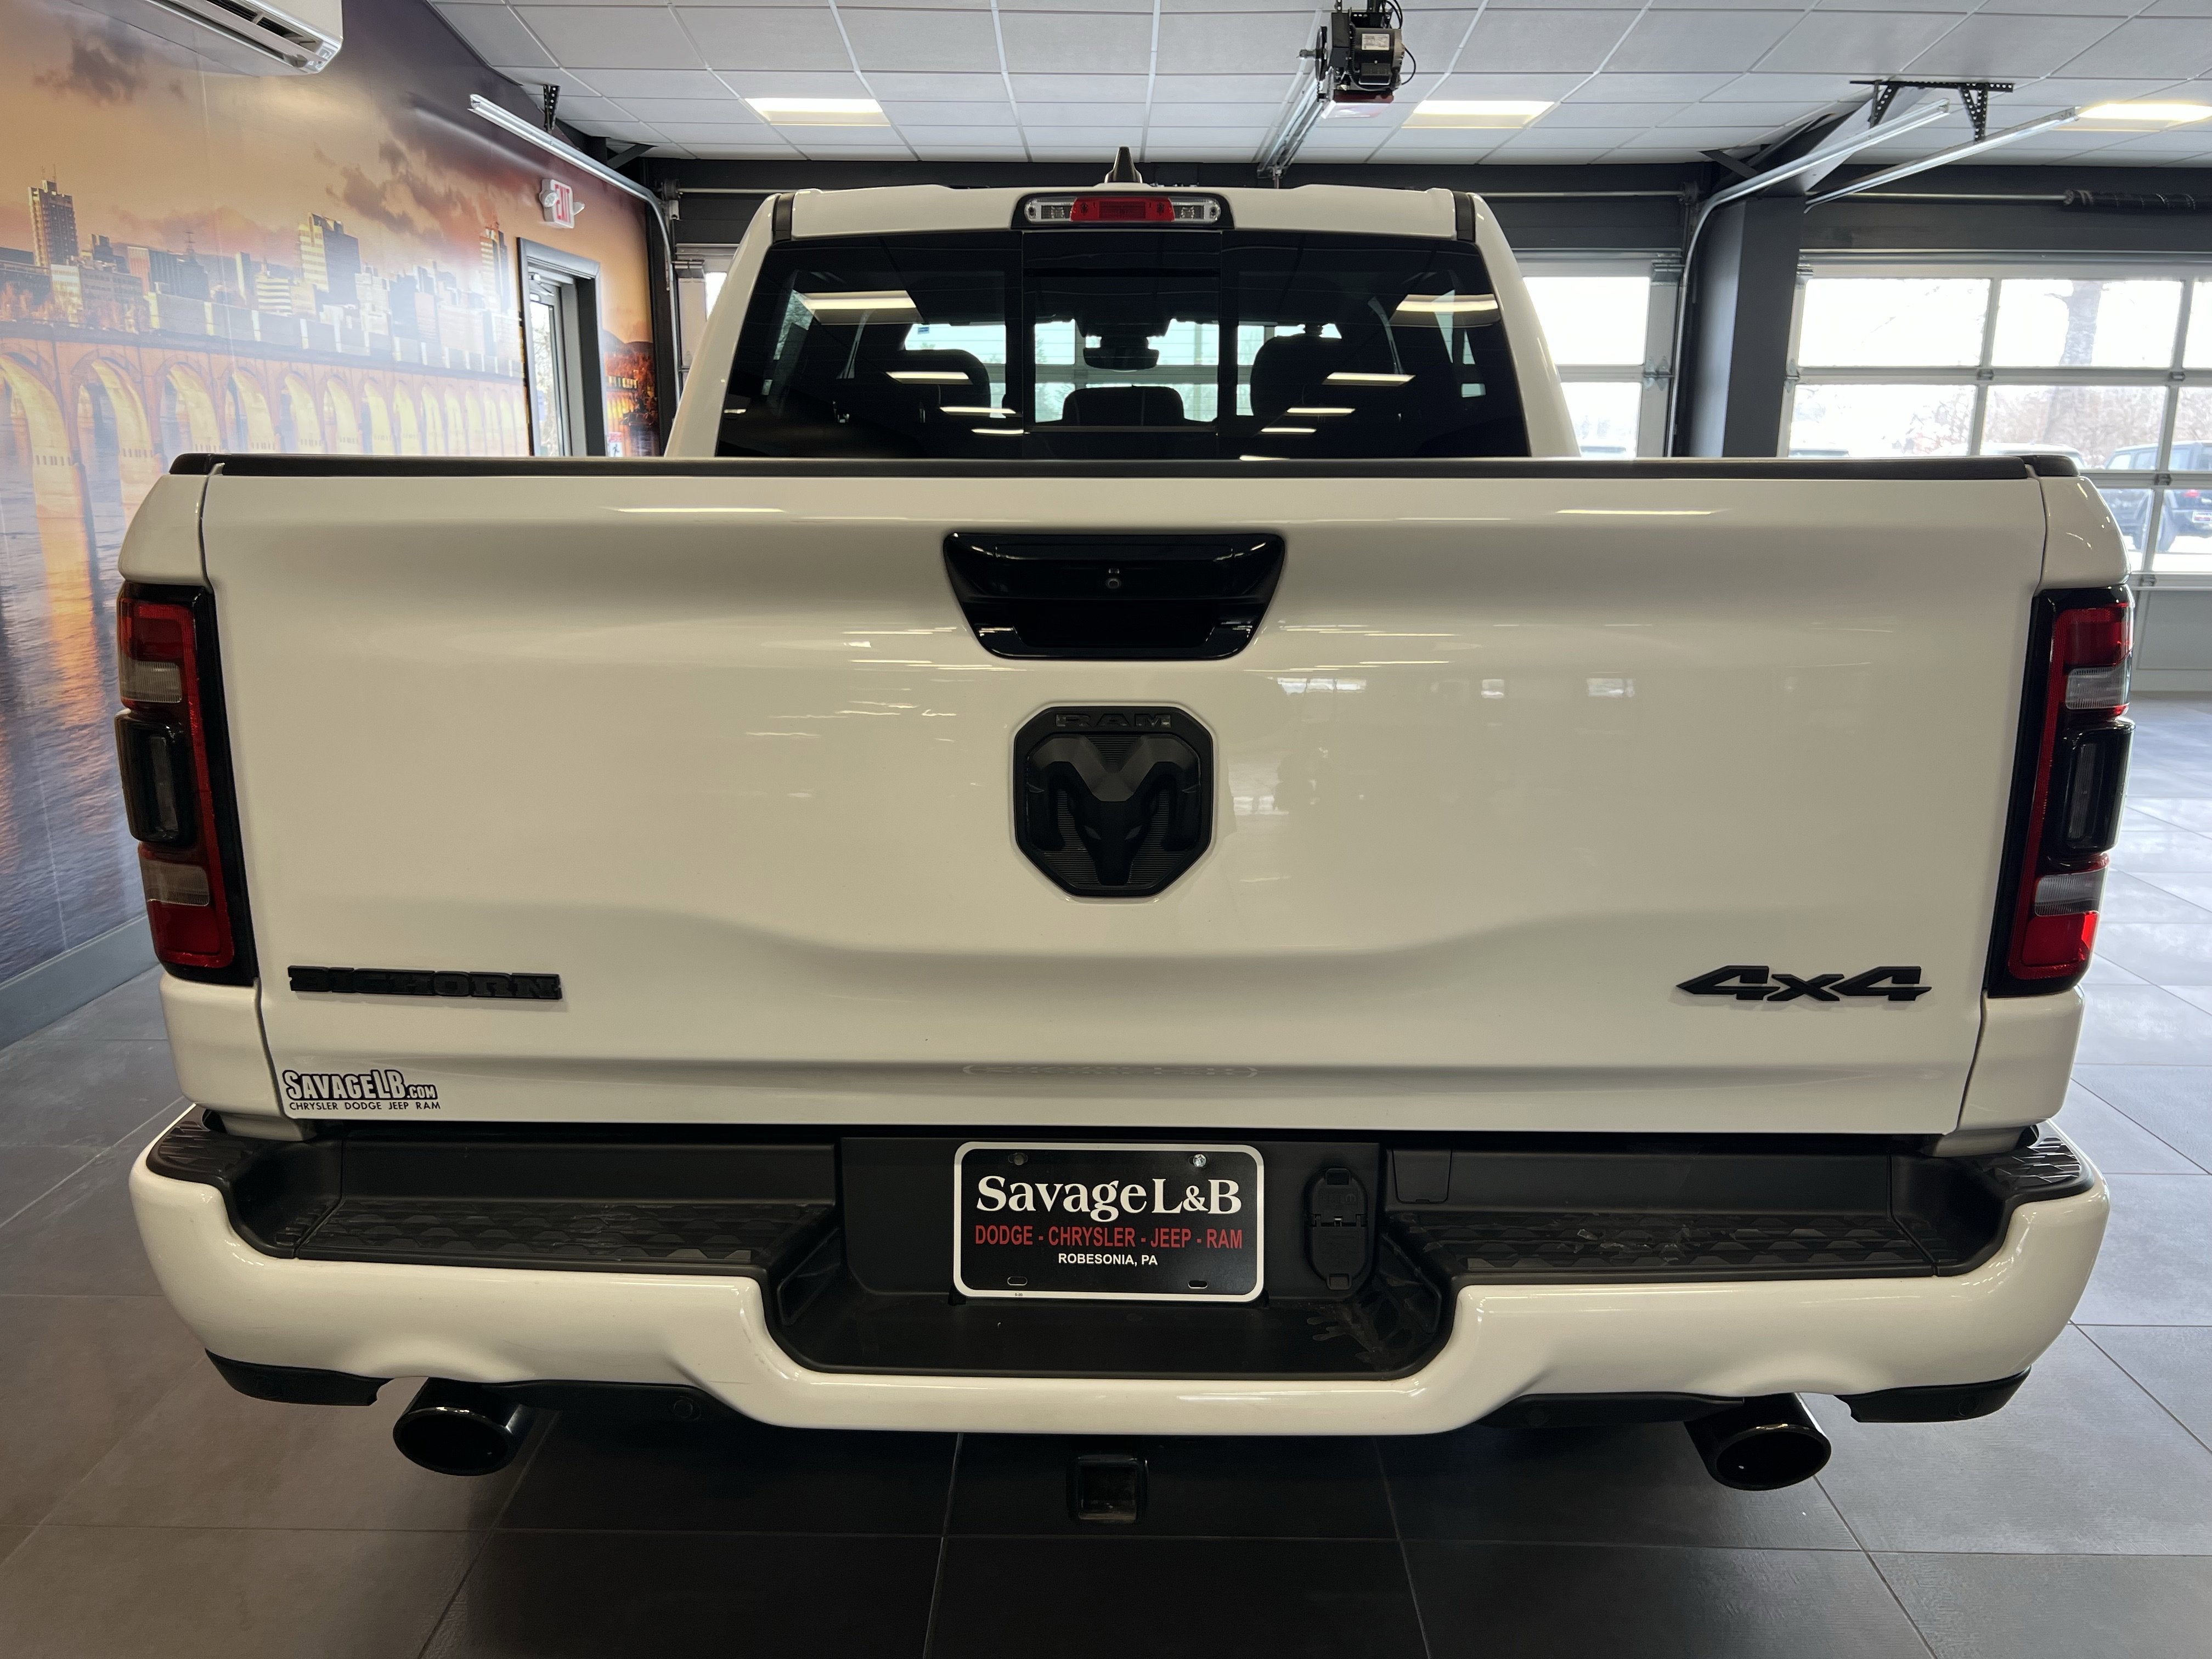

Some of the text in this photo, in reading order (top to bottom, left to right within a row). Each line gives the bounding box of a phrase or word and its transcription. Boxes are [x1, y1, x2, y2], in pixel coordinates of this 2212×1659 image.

[555, 184, 571, 224] EXIT
[1056, 714, 1172, 728] RAM
[1676, 966, 1932, 1001] 4x4
[289, 1102, 441, 1110] CHRYSLER DODGE JEEP RAM
[975, 1224, 1243, 1249] DODGE CHRYSLER JEEP RAM
[1058, 1253, 1158, 1267] ROBESONIA, PA
